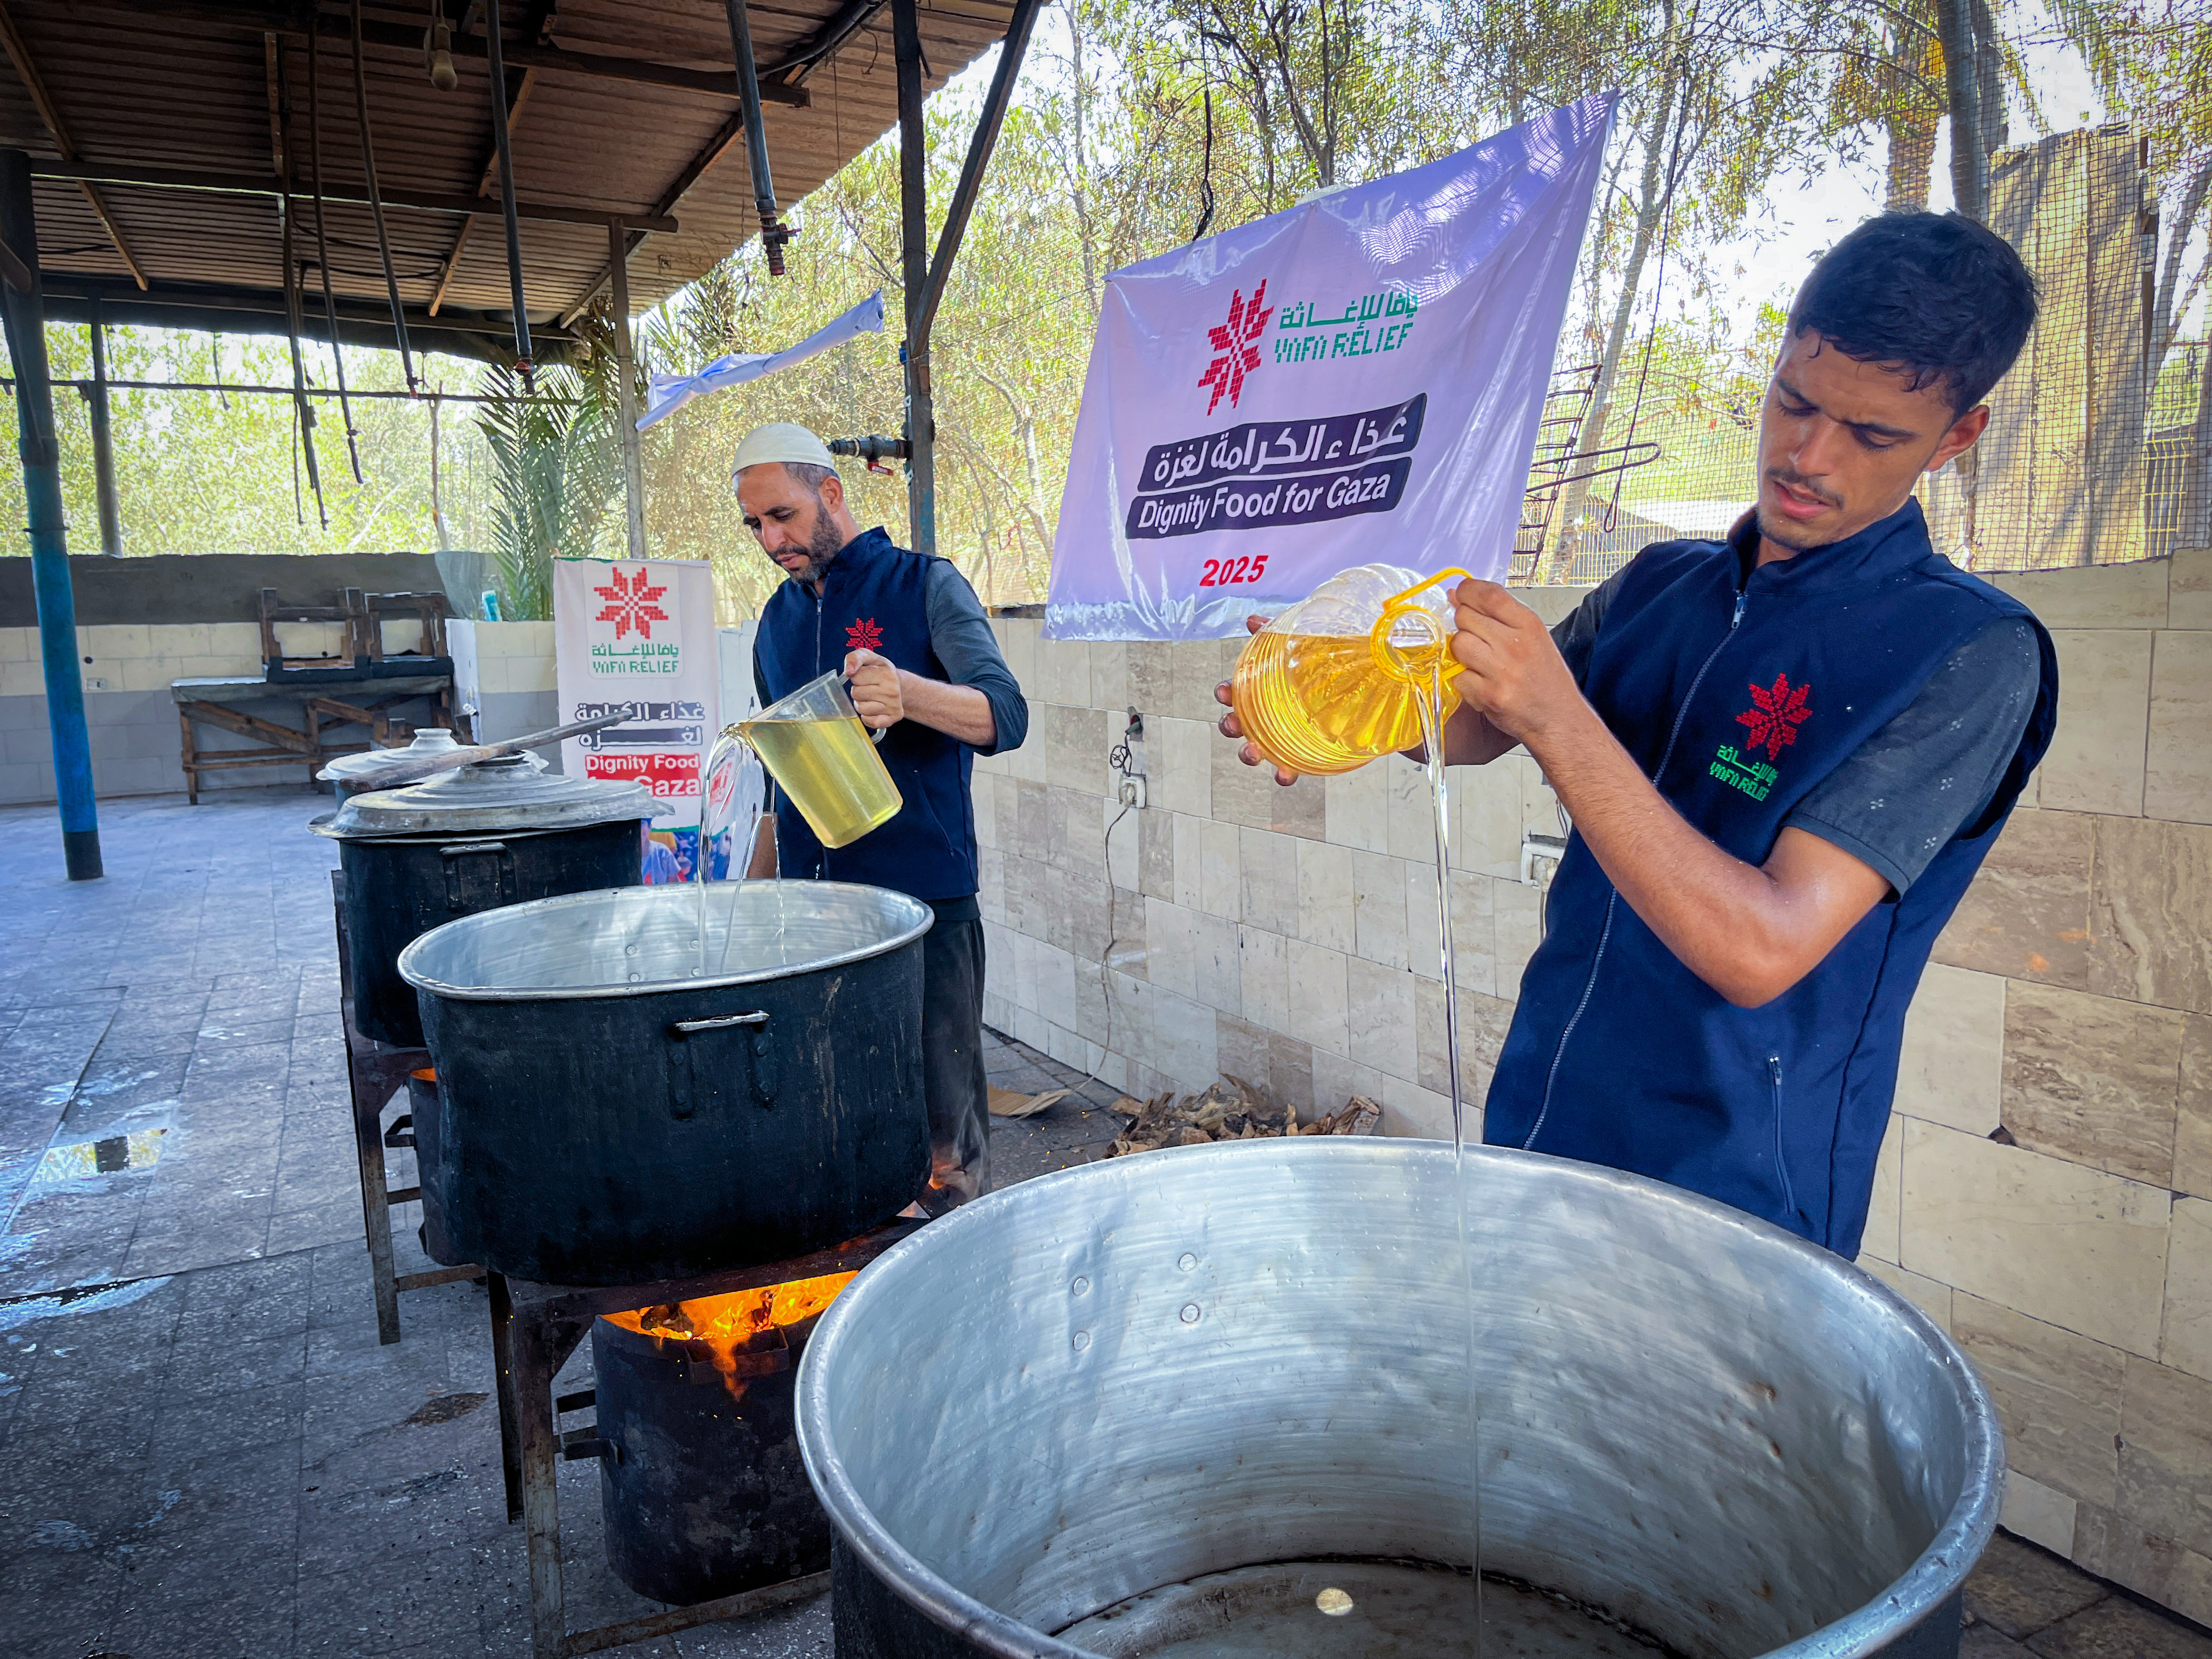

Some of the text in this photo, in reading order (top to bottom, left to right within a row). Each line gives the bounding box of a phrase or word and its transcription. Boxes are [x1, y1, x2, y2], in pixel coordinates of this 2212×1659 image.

[1274, 321, 1414, 363] YAFA RELIEF
[1154, 407, 1408, 488] غذاء الكرامة لغزة
[1138, 473, 1391, 534] Dignity Food for Gaza
[1199, 555, 1269, 587] 2025
[593, 661, 679, 673] YAFA RELIEF
[659, 701, 704, 720] غذاء
[585, 754, 699, 774] Dignity Food
